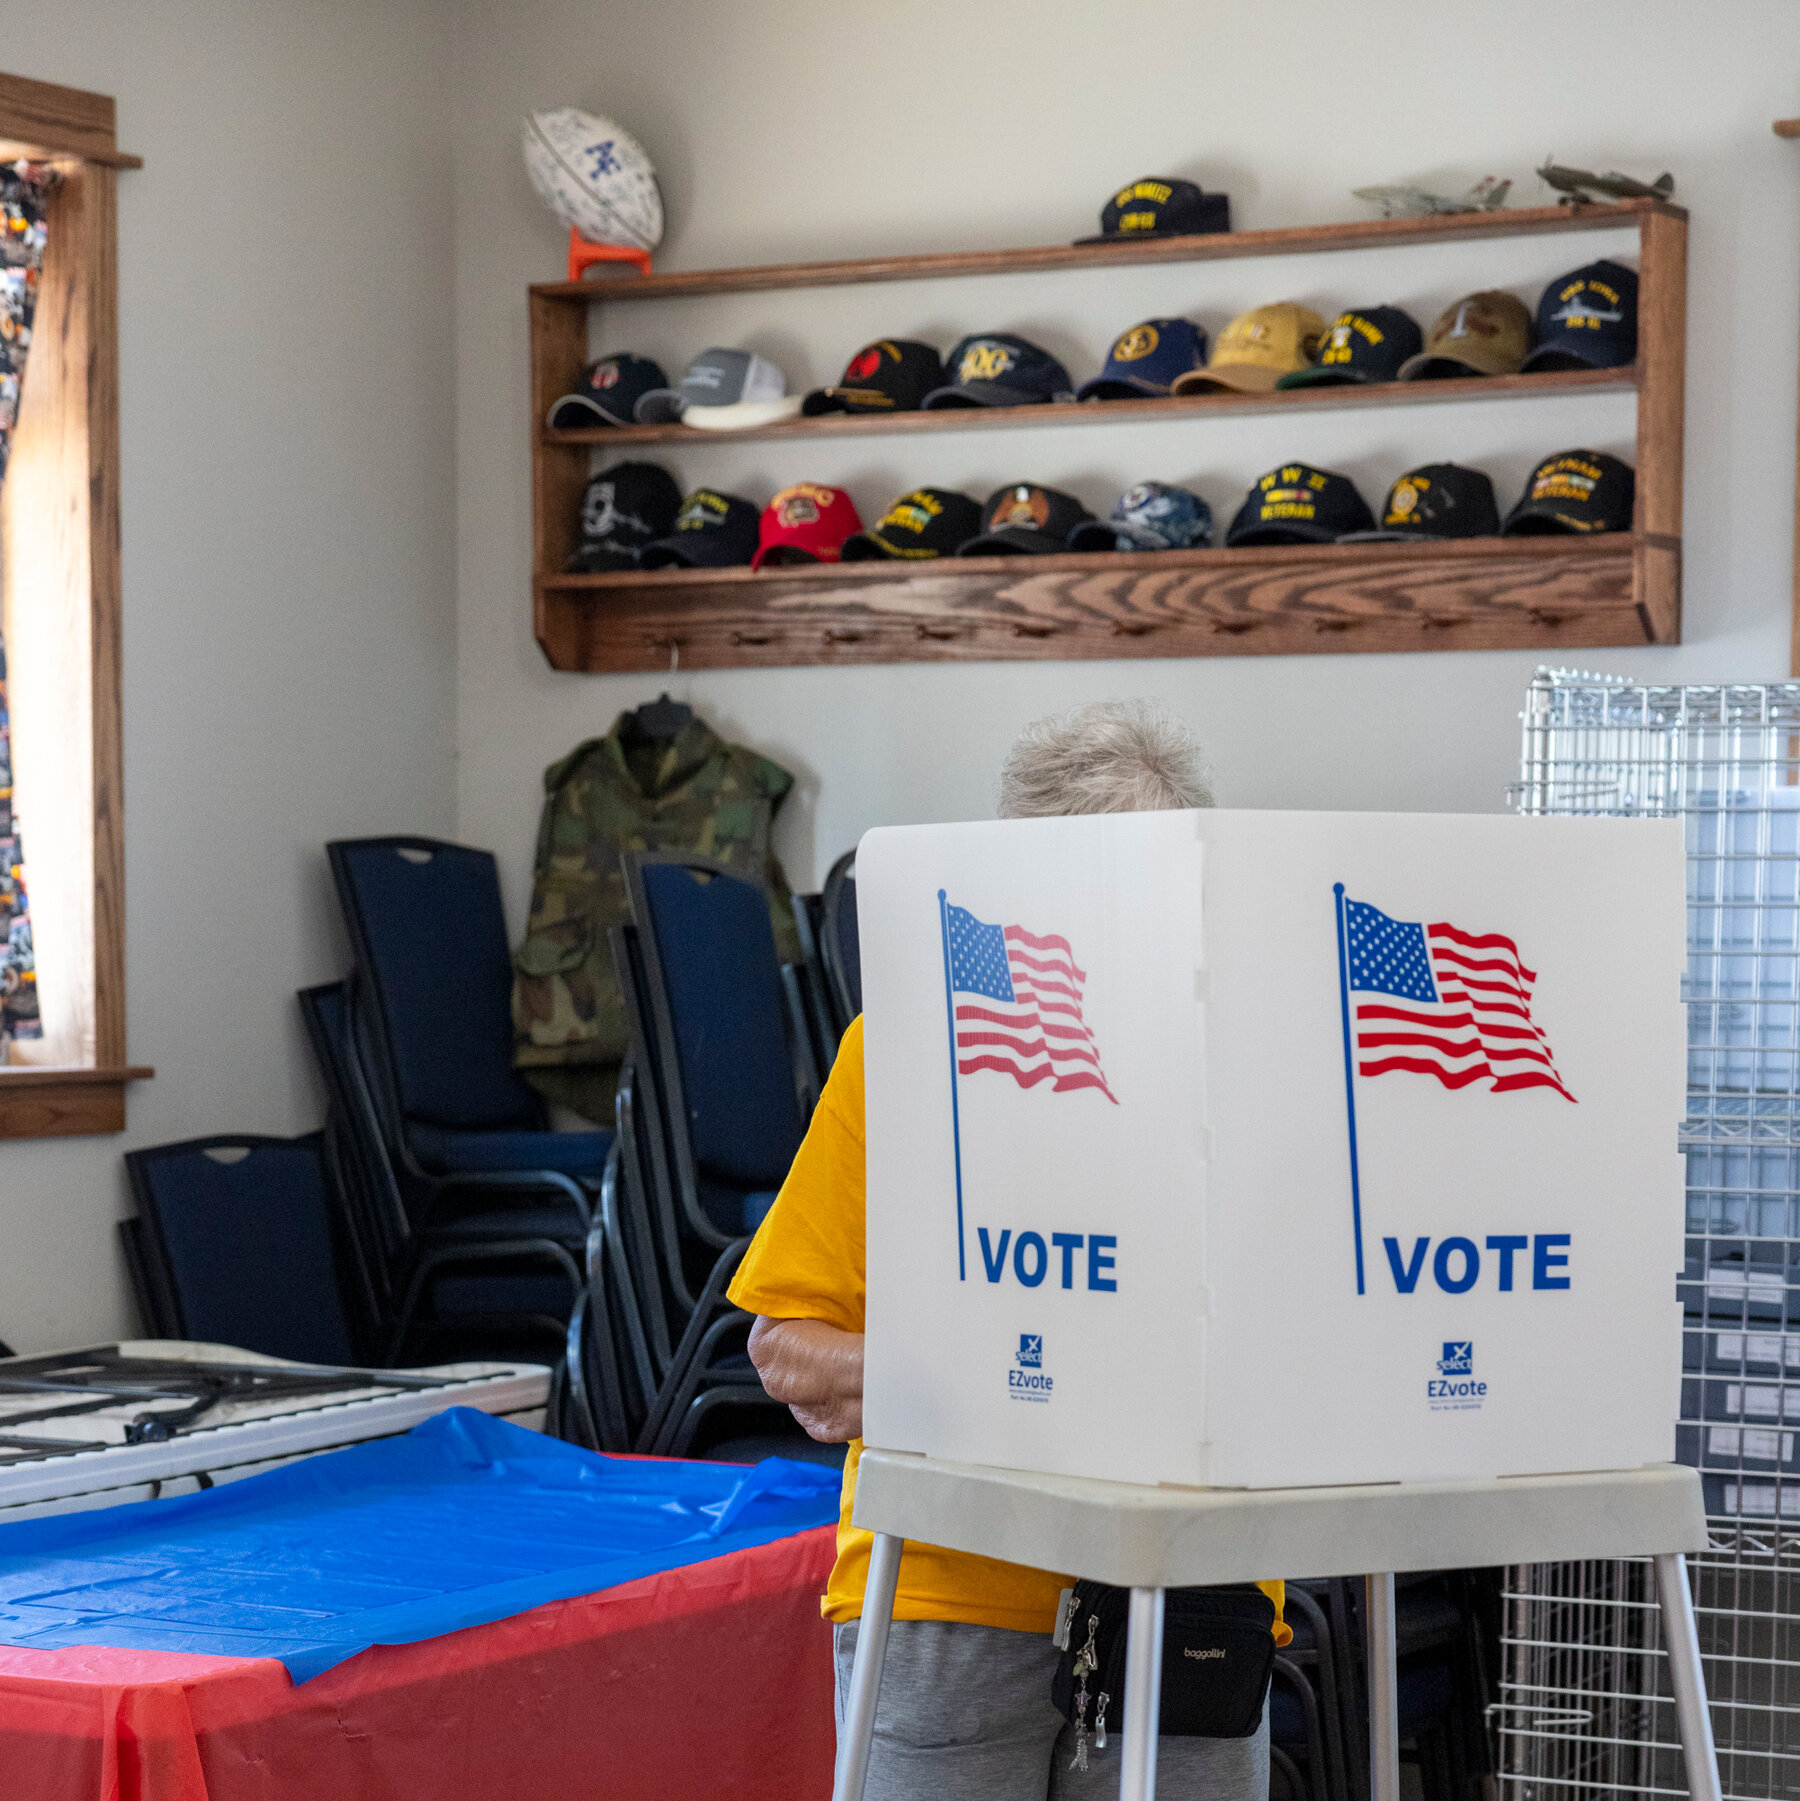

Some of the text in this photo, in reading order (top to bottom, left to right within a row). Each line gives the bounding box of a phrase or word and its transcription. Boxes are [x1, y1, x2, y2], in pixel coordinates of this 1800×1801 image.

[1260, 503, 1316, 521] VETERAN
[977, 1227, 1118, 1293] VOTE
[1382, 1233, 1572, 1295] VOTE
[1008, 1370, 1054, 1391] EZvote
[1427, 1379, 1488, 1397] EZvote
[1183, 1646, 1227, 1660] baggallini
